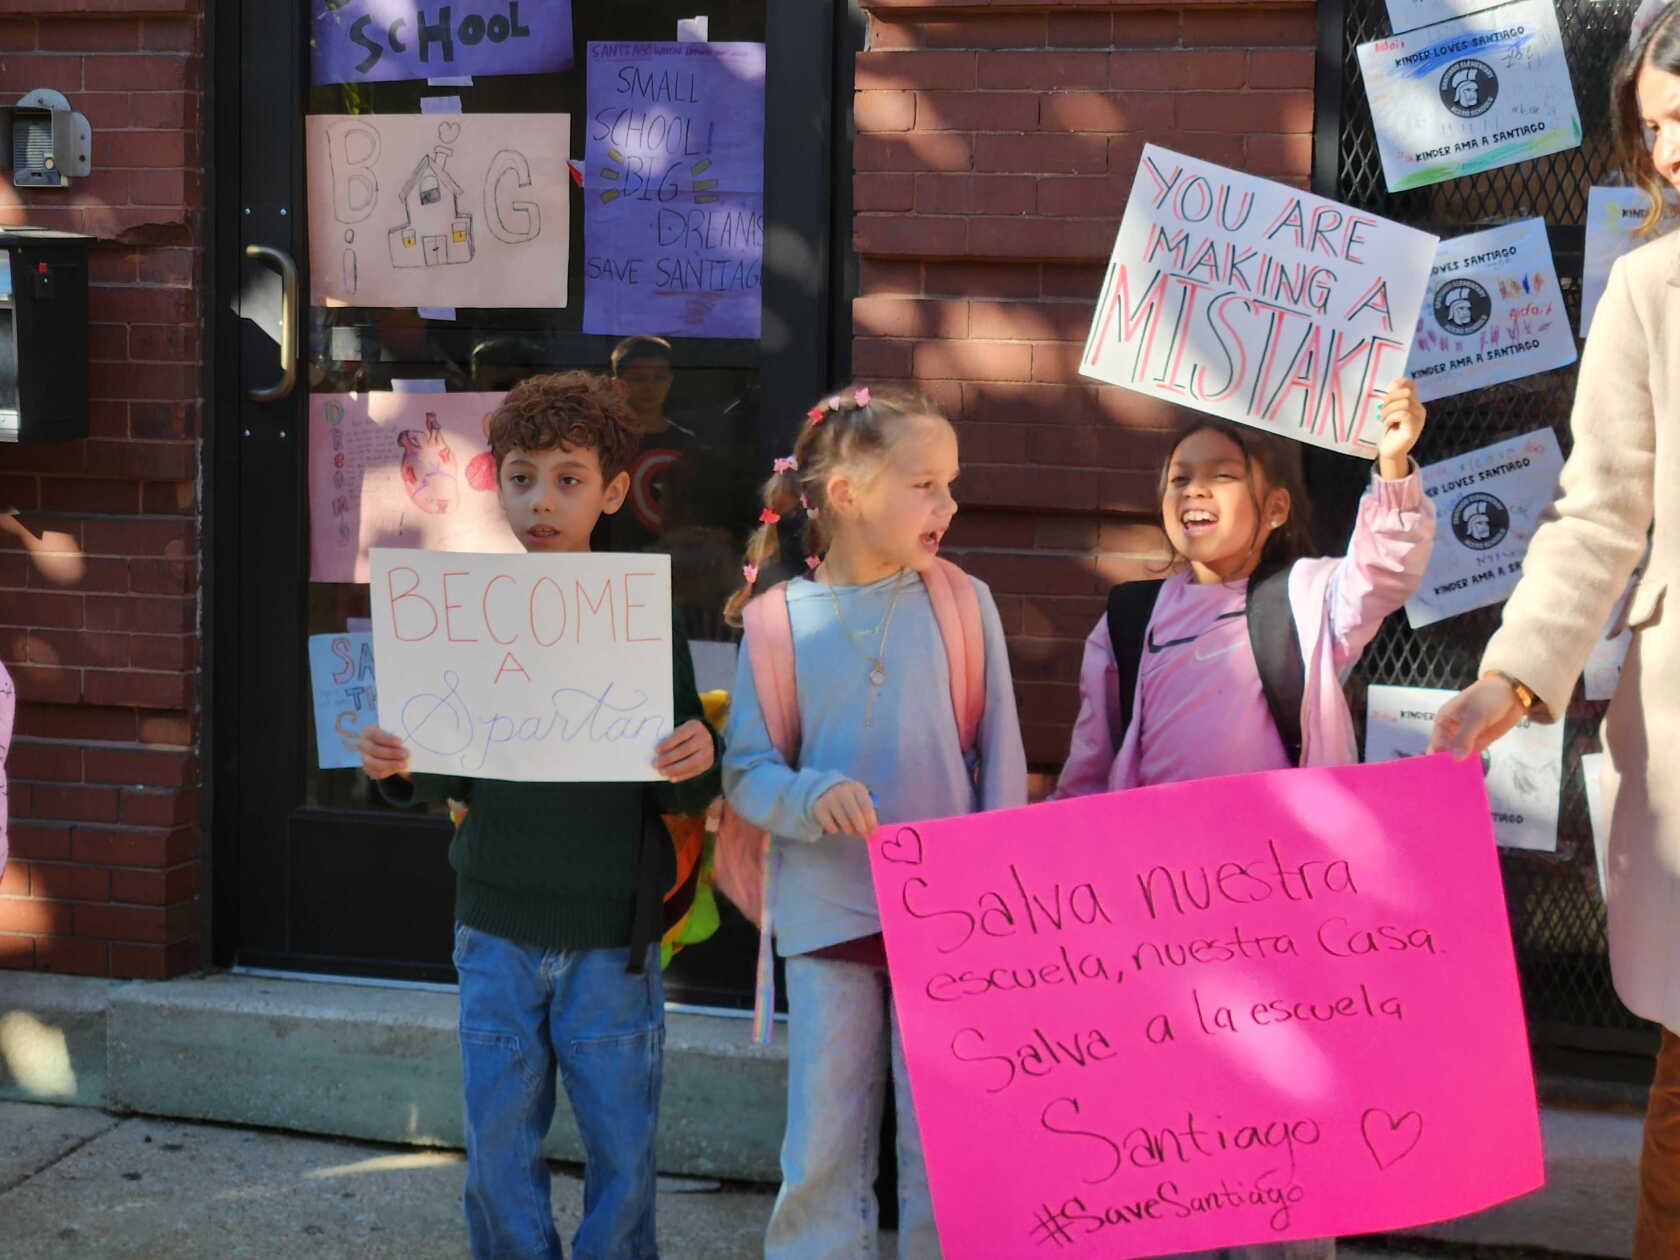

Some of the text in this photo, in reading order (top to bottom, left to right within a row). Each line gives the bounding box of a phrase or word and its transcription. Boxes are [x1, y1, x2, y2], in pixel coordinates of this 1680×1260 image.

[350, 1, 530, 73] SCHOOL
[1395, 26, 1525, 68] KINDER LOVES SANTIAGO
[616, 66, 699, 104] SMALL
[1415, 121, 1546, 163] KINDER AMA A SANTIAGO
[623, 155, 683, 202] BIG
[1142, 157, 1377, 265] YOU ARE
[587, 257, 644, 285] SAVE
[1143, 223, 1337, 315] MAKING
[1344, 276, 1394, 332] A
[1431, 246, 1518, 276] OVES SANTIAGO
[1084, 263, 1406, 449] MISTAKE
[1410, 338, 1541, 380] KINDER AMA A SANTIAGO
[1441, 475, 1475, 493] LOVES
[1478, 457, 1531, 482] SANTIAGO
[388, 566, 662, 647] BECOME
[1433, 578, 1469, 595] KINDER
[1472, 570, 1495, 585] AMA
[1497, 565, 1505, 577] A
[494, 651, 531, 684] A
[401, 670, 665, 770] Spartan
[902, 839, 1358, 954] Salva nuestra
[926, 946, 1125, 1002] escuela,
[1133, 926, 1297, 973] nuestra
[951, 984, 1404, 1093] Salva a la escuela
[1040, 1097, 1321, 1187] Santiago
[1029, 1180, 1305, 1249] #SaveSantiago
